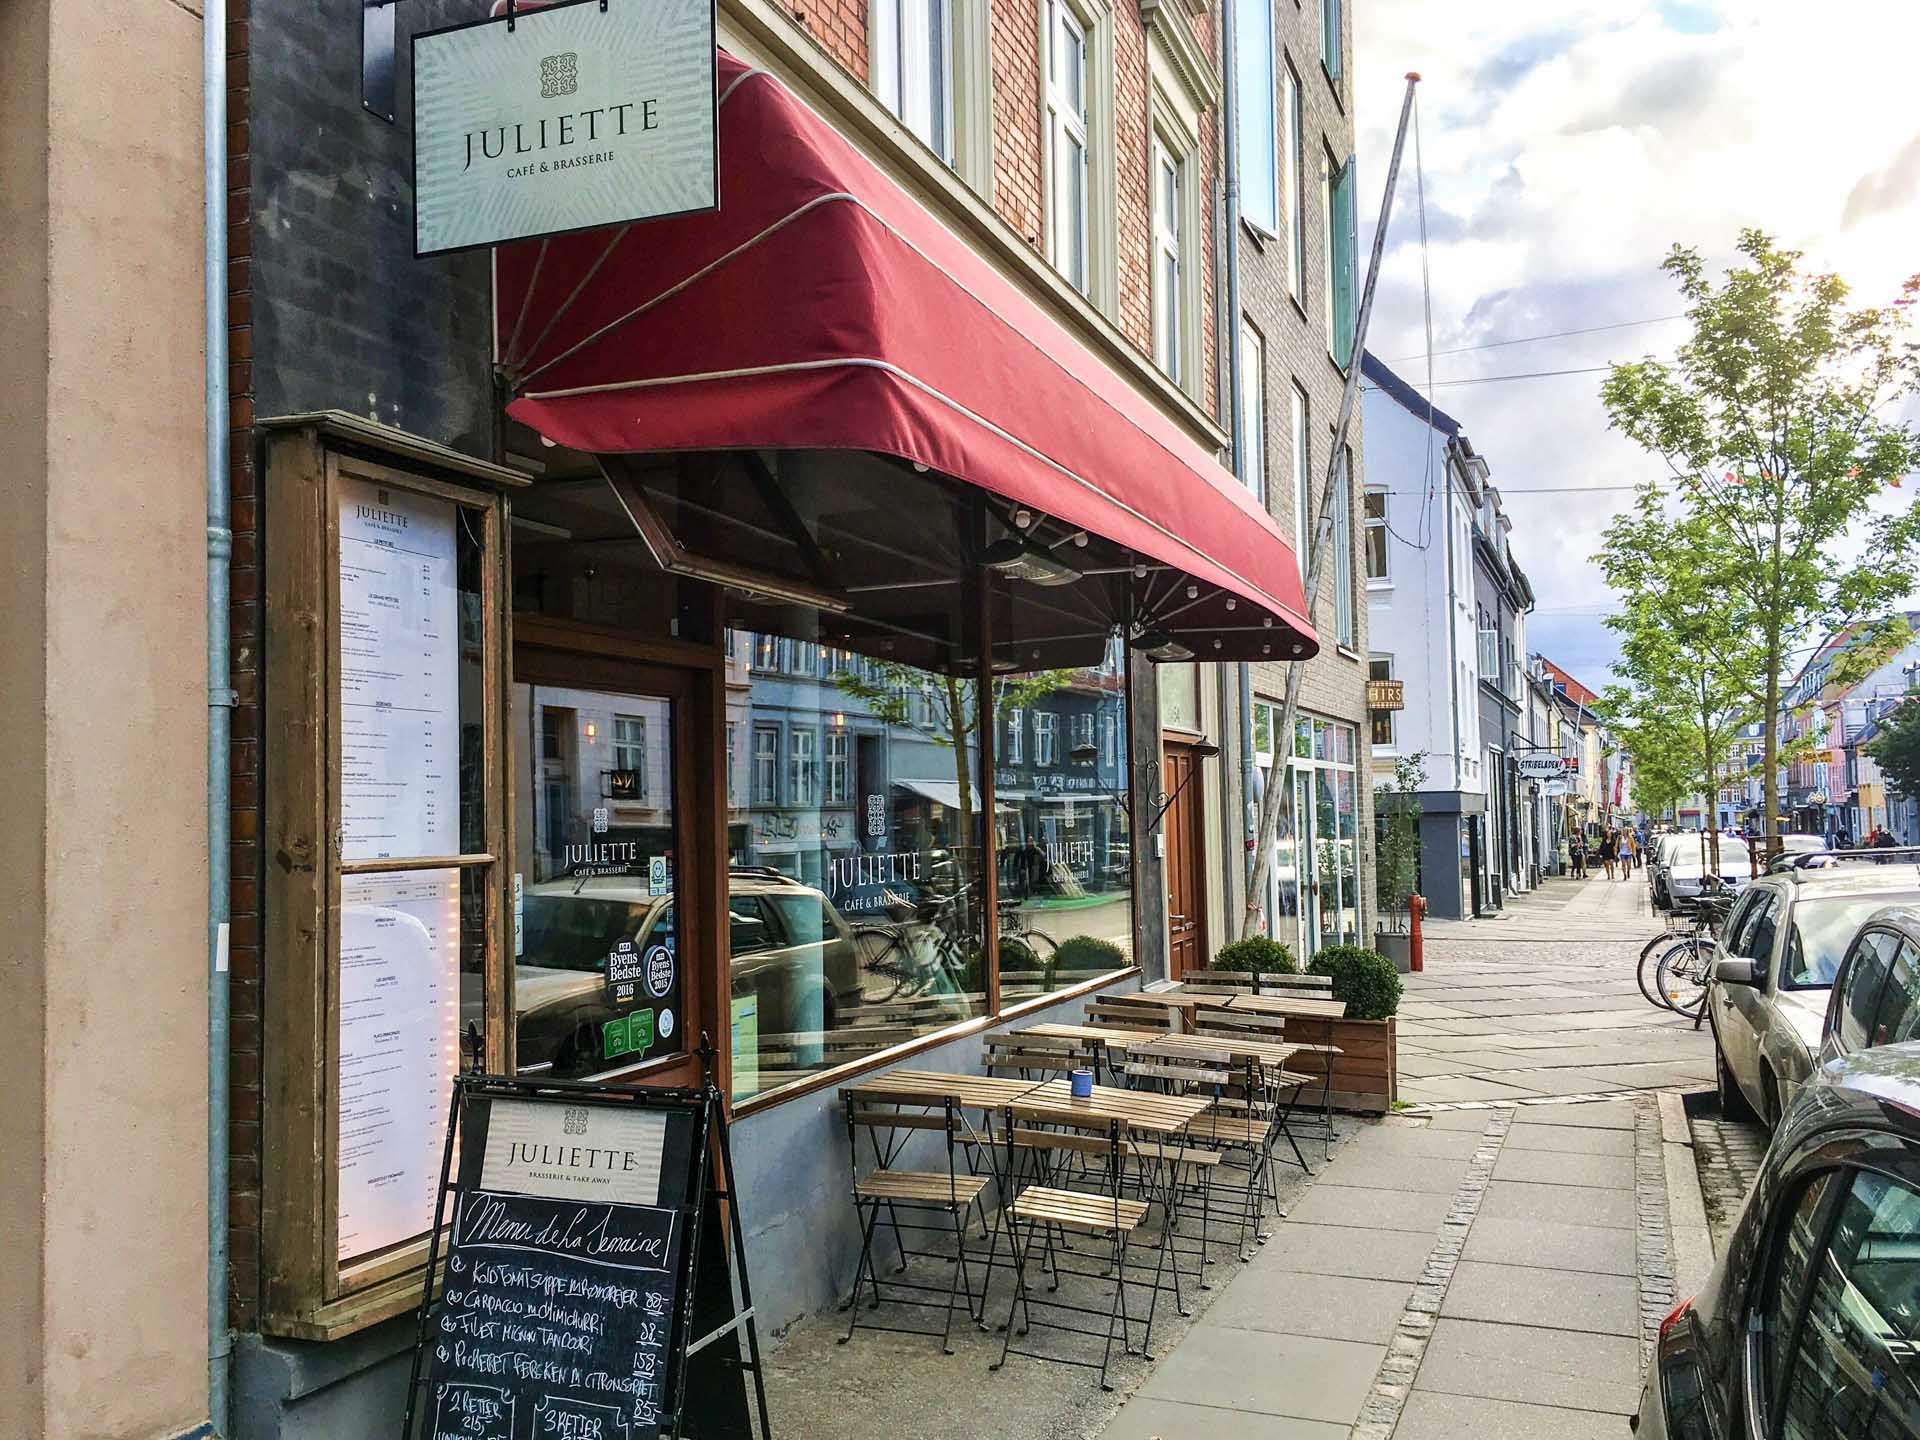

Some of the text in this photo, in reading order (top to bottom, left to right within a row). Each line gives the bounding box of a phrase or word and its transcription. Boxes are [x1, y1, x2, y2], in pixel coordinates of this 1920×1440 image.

[463, 99, 659, 172] JULIETTE
[506, 151, 614, 178] CAFÉ & BRASSERIE
[356, 505, 408, 528] JULIETTE
[1368, 688, 1401, 701] HIRS
[564, 842, 637, 870] JULIETTE
[1046, 841, 1094, 873] JULIETTE
[832, 852, 920, 899] JULIETTE
[865, 898, 872, 908] &
[610, 952, 638, 968] Byens
[651, 960, 670, 971] Byens
[610, 965, 642, 981] Bedste
[651, 970, 671, 981] Bedste
[616, 983, 634, 997] 2016
[654, 979, 668, 990] 2015
[507, 1142, 635, 1171] JULIETTE
[529, 1171, 564, 1181] BRASSERIE
[573, 1175, 589, 1183] TAKE
[592, 1177, 611, 1185] AWAY
[465, 1195, 532, 1243] Menu
[535, 1214, 559, 1246] de
[587, 1206, 662, 1259] Semaine
[448, 1391, 461, 1412] 2
[544, 1410, 603, 1438] 3 RETTER
